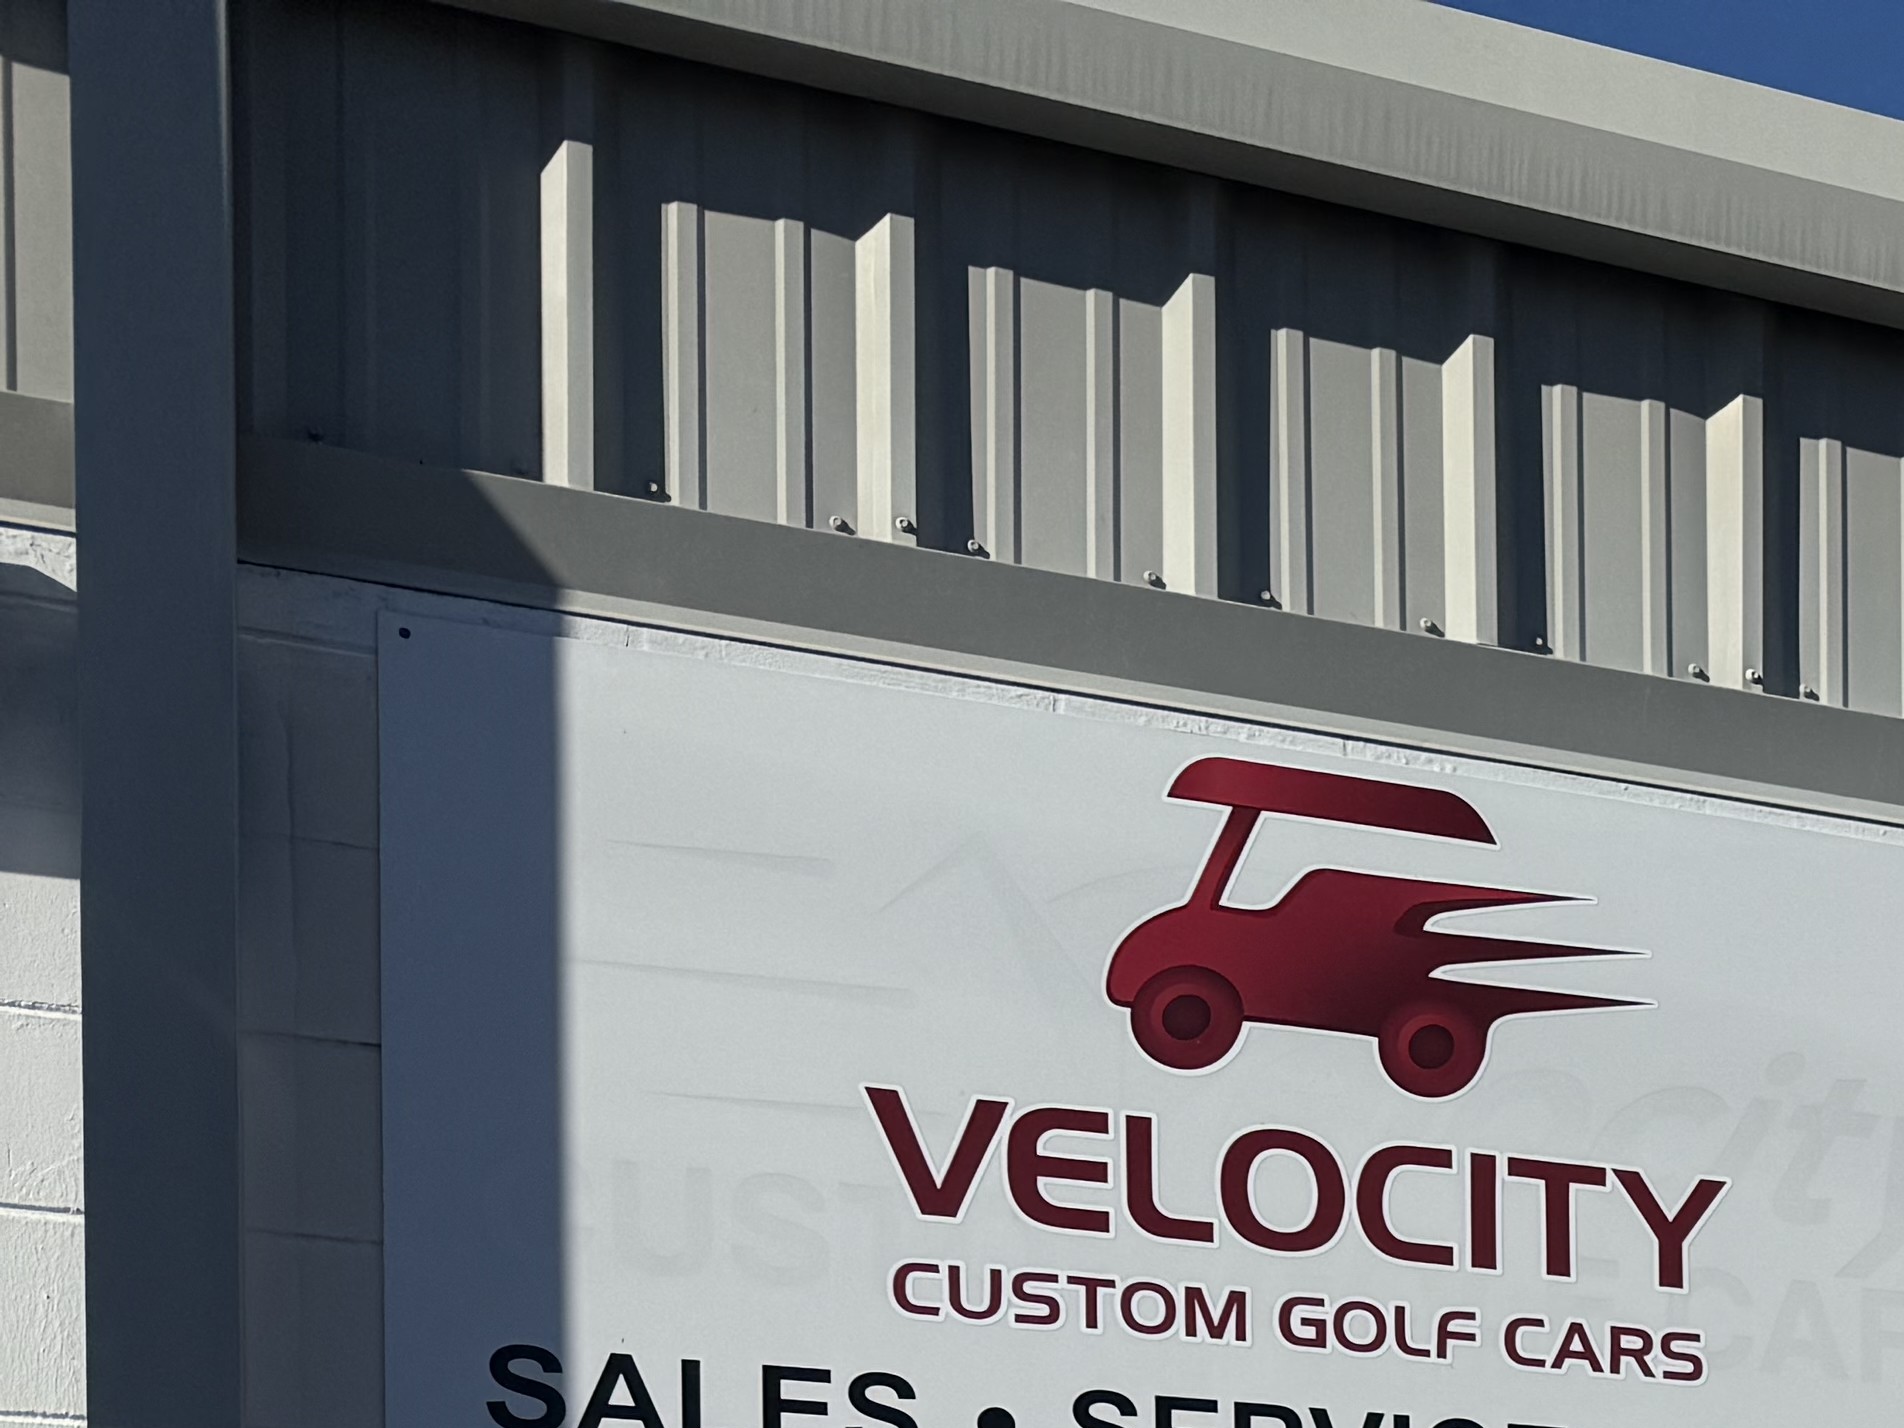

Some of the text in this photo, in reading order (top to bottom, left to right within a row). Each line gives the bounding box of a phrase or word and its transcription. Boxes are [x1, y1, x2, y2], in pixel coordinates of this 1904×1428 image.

[864, 1085, 1727, 1289] VELOCITY
[891, 1262, 1703, 1383] CUSTOM GOLF CARS
